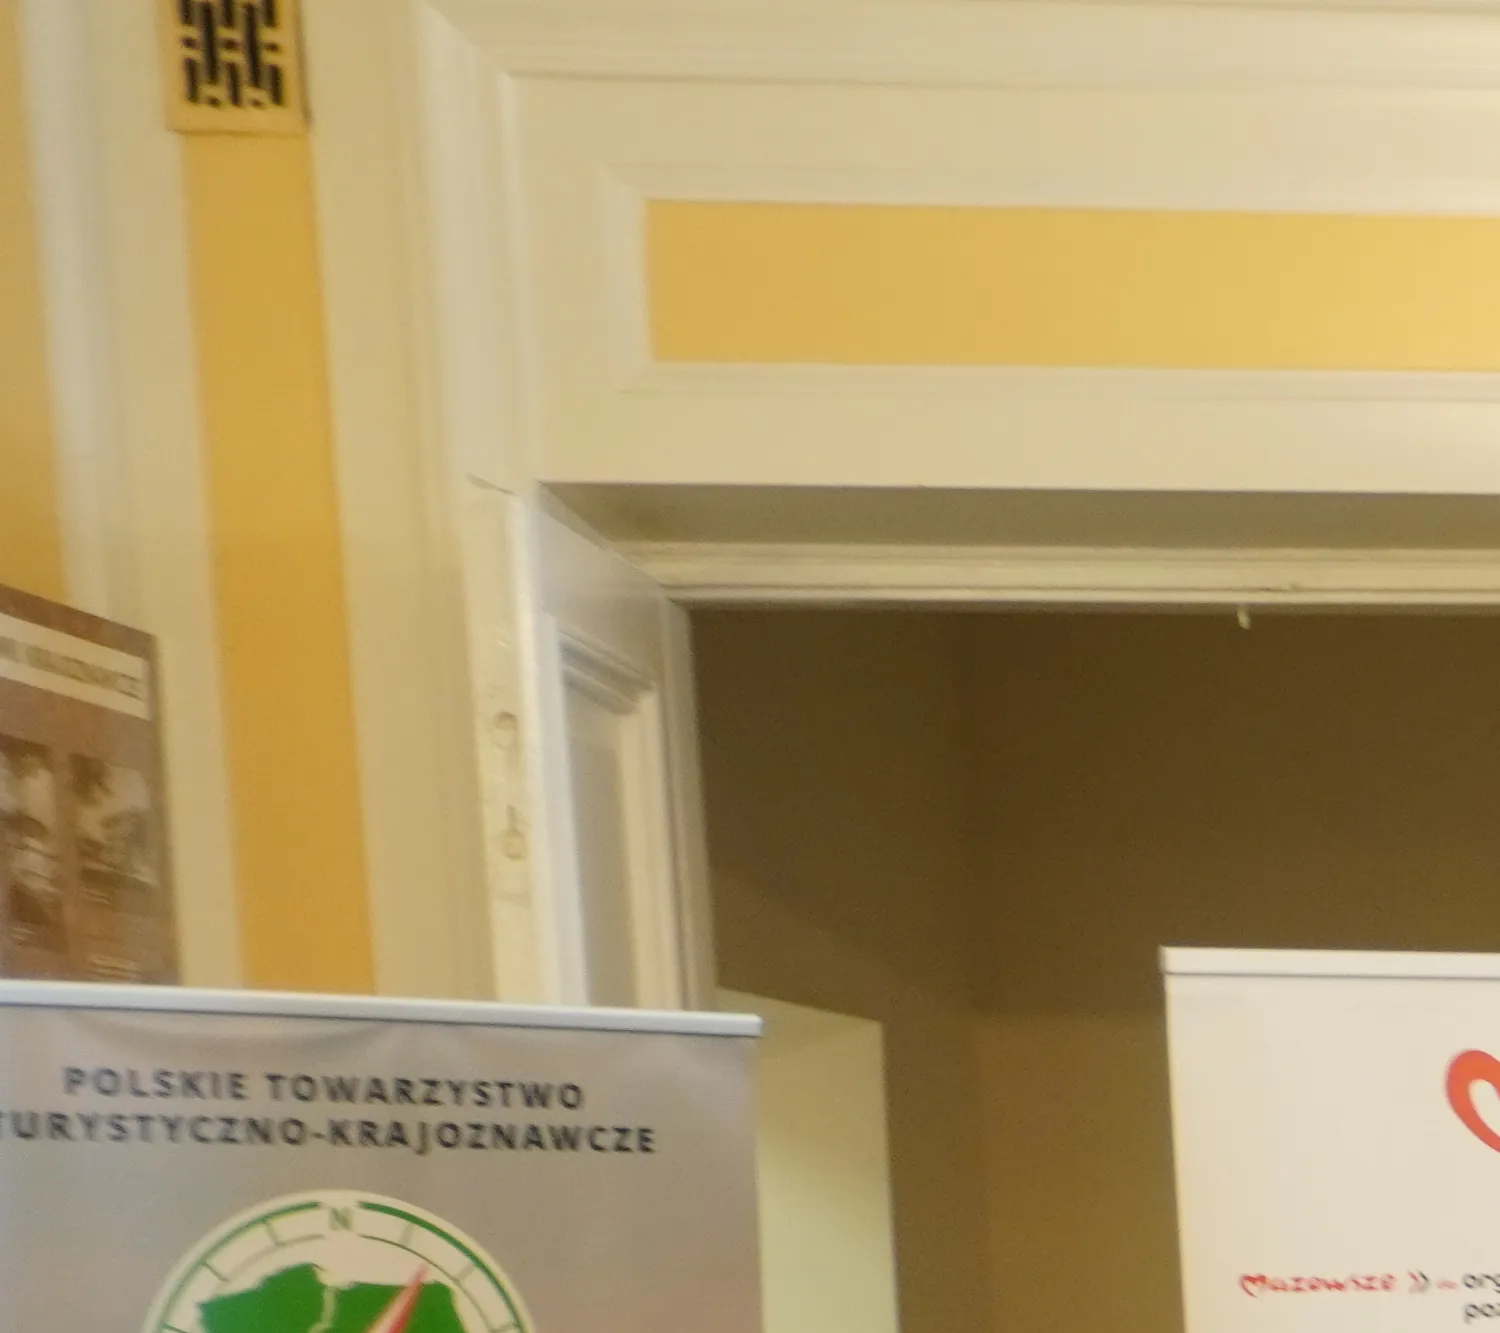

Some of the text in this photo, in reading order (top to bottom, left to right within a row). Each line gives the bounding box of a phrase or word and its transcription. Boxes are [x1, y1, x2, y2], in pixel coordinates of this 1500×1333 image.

[64, 1066, 583, 1110] POLSKIE TOWARZYSTWO
[0, 1110, 656, 1156] URYSTYCZNO-KRAJOZNAWCZE
